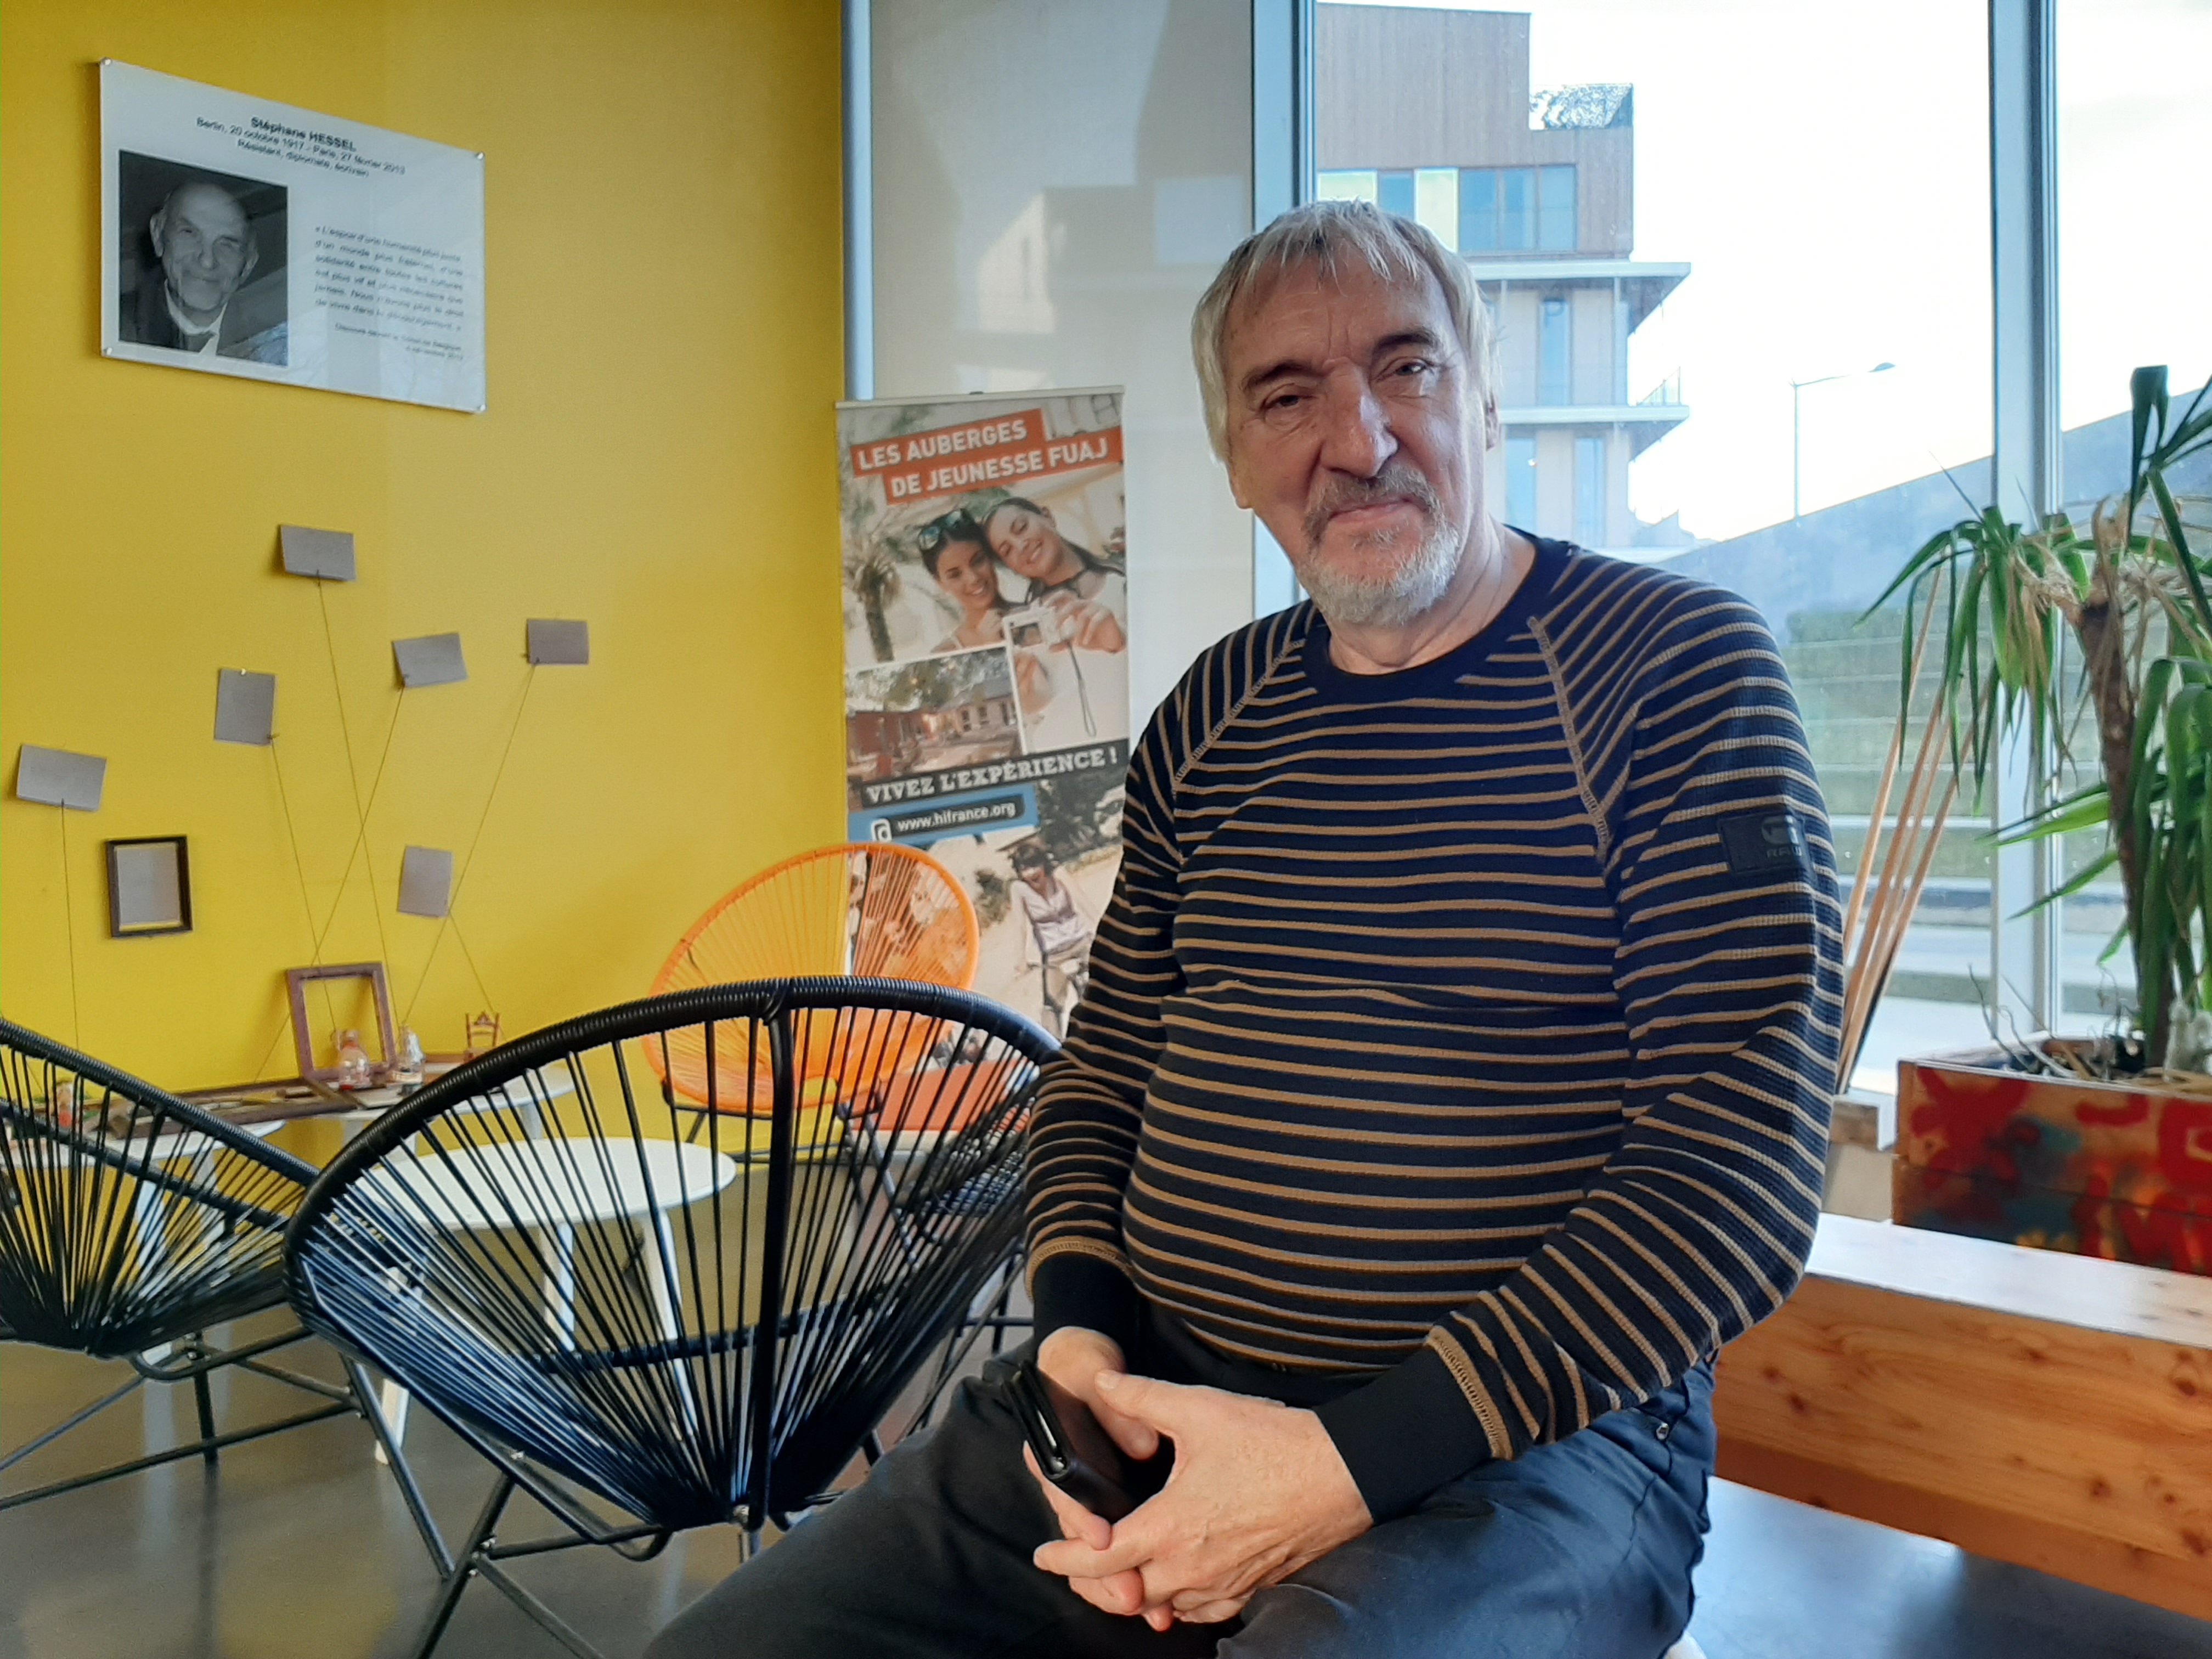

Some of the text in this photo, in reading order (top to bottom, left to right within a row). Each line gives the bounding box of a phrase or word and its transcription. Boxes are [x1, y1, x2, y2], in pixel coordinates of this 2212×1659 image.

[196, 116, 228, 134] Berlin,
[229, 125, 243, 136] 20
[244, 130, 280, 145] octobre
[281, 138, 305, 152] 1917
[313, 144, 338, 161] Paris,
[340, 151, 352, 162] 27
[354, 154, 382, 168] février
[383, 161, 406, 176] 2013
[251, 116, 357, 152] Stéphane HESSEL
[858, 419, 1028, 471] LES AUBERGES
[891, 437, 1108, 498] DE JEUNESSE FUAJ
[866, 745, 1118, 804] VIVEZ L'EXPÉRIENCE !
[898, 803, 1016, 832] www.hifrance.org
